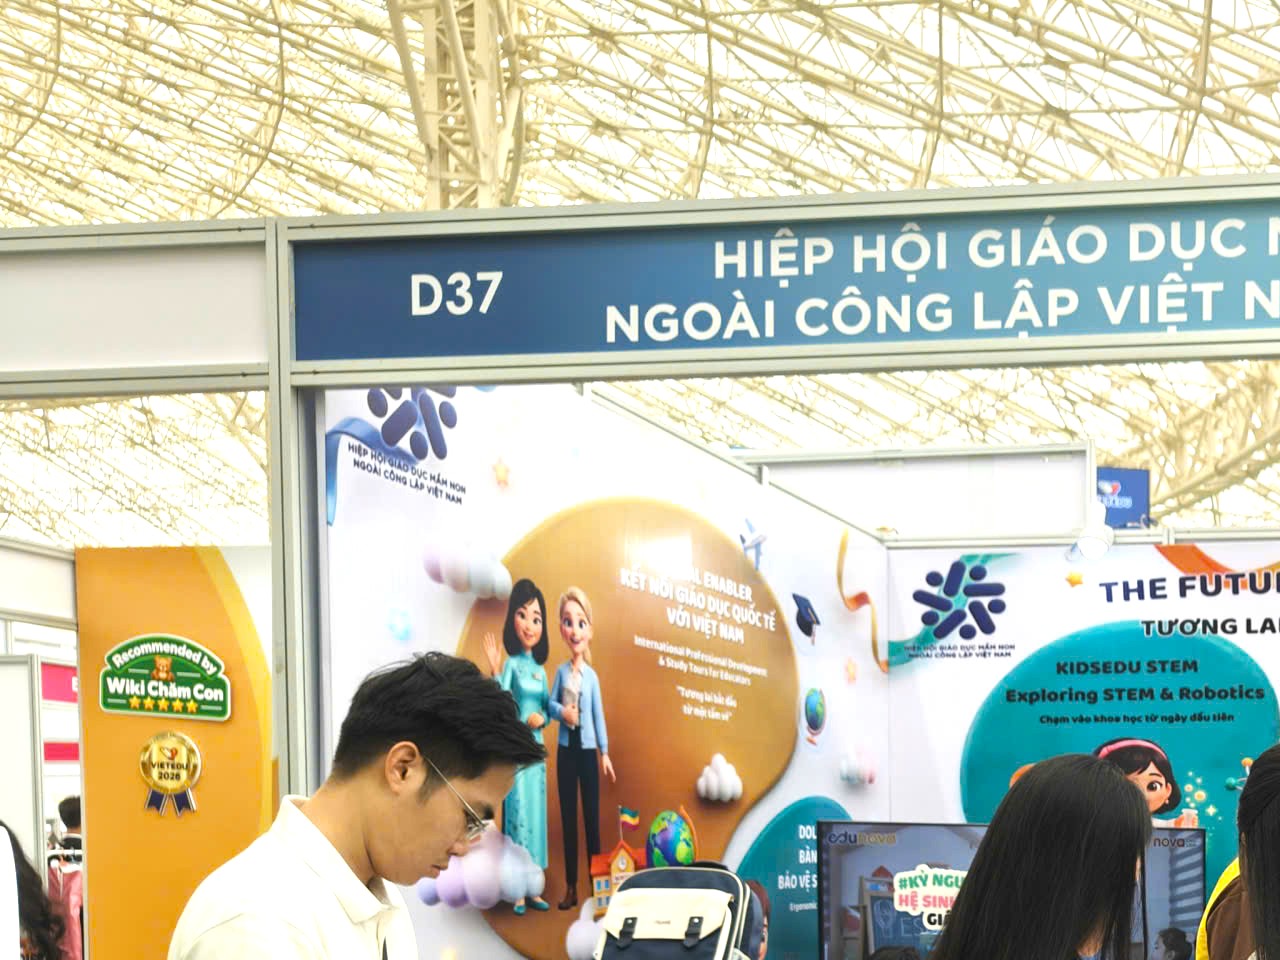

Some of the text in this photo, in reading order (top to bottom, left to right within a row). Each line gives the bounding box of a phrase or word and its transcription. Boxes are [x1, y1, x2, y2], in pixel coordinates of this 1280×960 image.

[715, 227, 835, 288] HIỆP
[853, 222, 947, 283] HỘI
[969, 211, 1101, 268] GIÁO
[1129, 217, 1248, 271] DỤC
[411, 271, 503, 317] D37
[606, 291, 774, 344] NGOÀI
[795, 286, 953, 338] CÔNG
[974, 278, 1079, 338] LẬP
[1097, 273, 1225, 333] VIỆT
[703, 571, 752, 601] ENABLER
[1100, 578, 1167, 602] THE
[667, 607, 745, 644] VỚI VIỆT NAM
[1141, 617, 1238, 637] TƯƠNG
[112, 641, 217, 675] Recommended by
[1056, 659, 1198, 675] KIDSEDU STEM
[107, 677, 224, 701] Wiki Chăm Con
[1006, 686, 1264, 705] Exploring STEM & Robotics
[899, 891, 919, 910] HỆ
